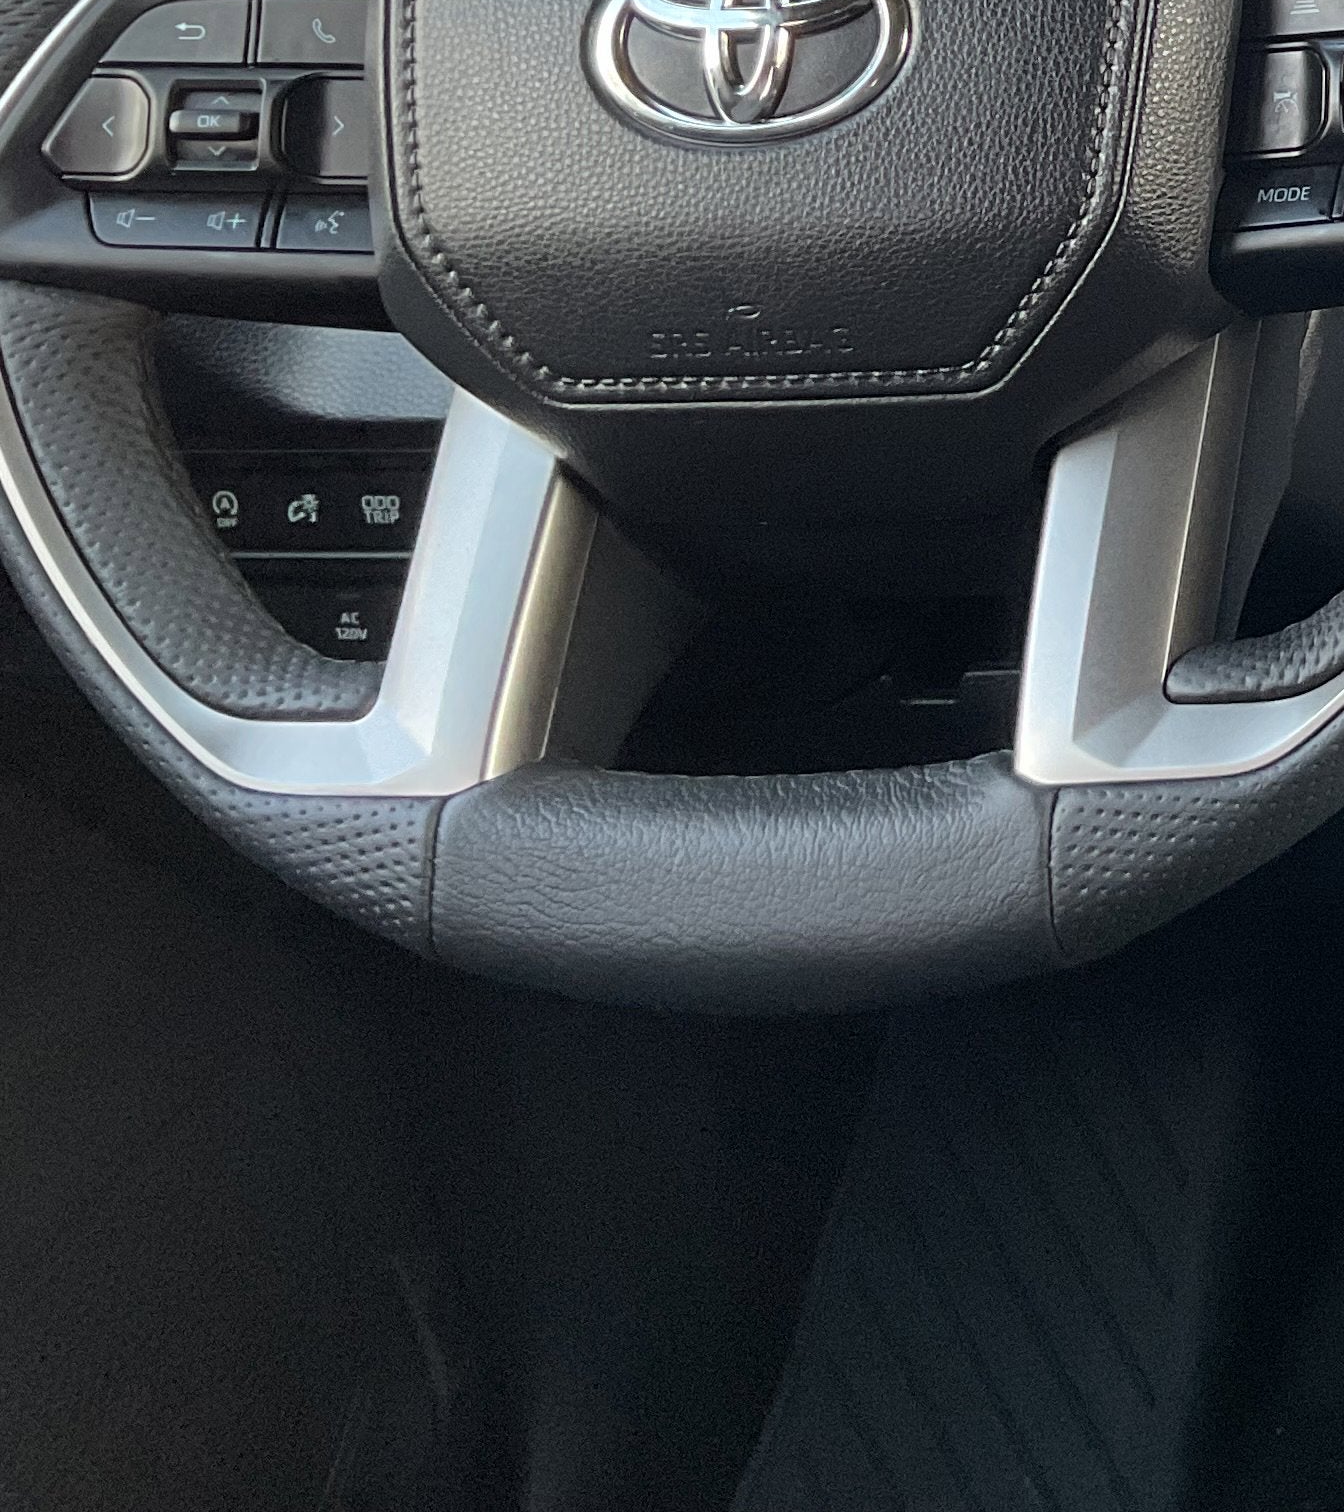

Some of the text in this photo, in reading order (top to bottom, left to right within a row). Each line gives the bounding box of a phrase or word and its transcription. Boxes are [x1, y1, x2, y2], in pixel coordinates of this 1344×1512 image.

[196, 114, 221, 128] OK
[1257, 186, 1312, 203] MODE
[364, 511, 400, 525] TRIP
[340, 612, 360, 625] AC
[335, 627, 369, 641] 120V
